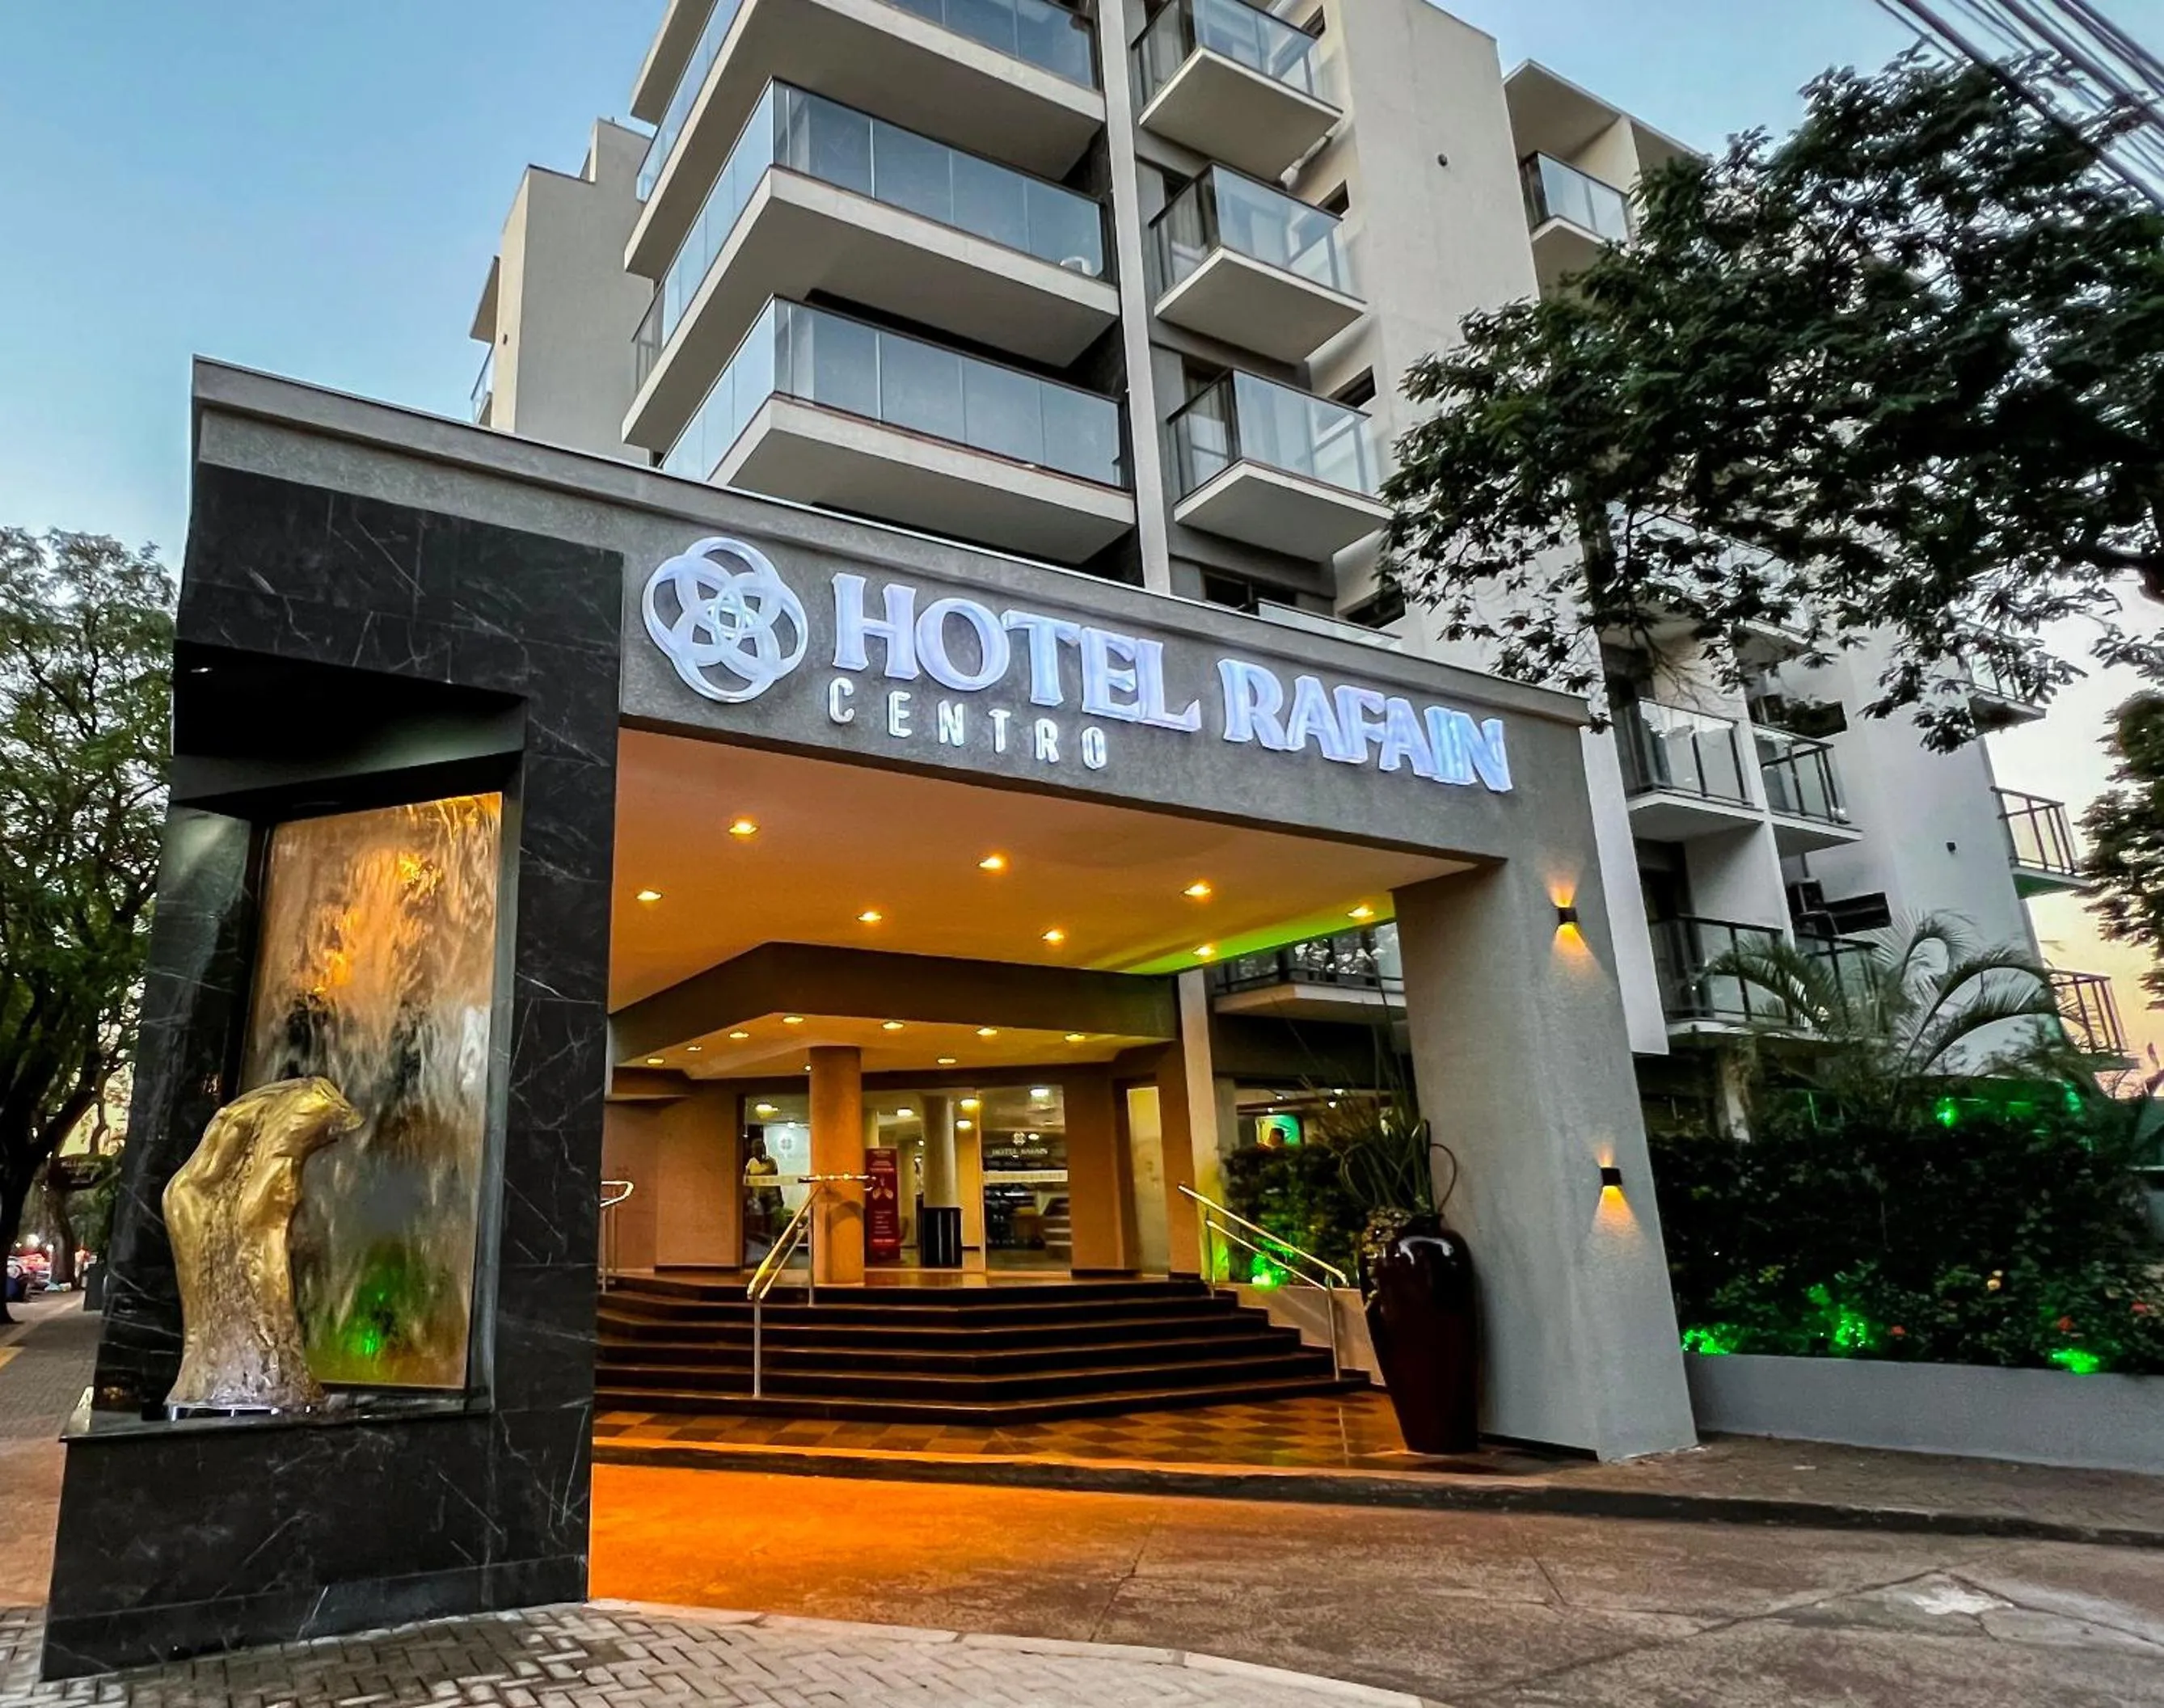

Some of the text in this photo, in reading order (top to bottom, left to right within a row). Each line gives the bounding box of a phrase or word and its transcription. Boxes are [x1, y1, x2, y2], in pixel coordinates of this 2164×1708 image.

[828, 677, 1107, 770] CENTRO
[831, 572, 1512, 792] HOTEL RAFAIN
